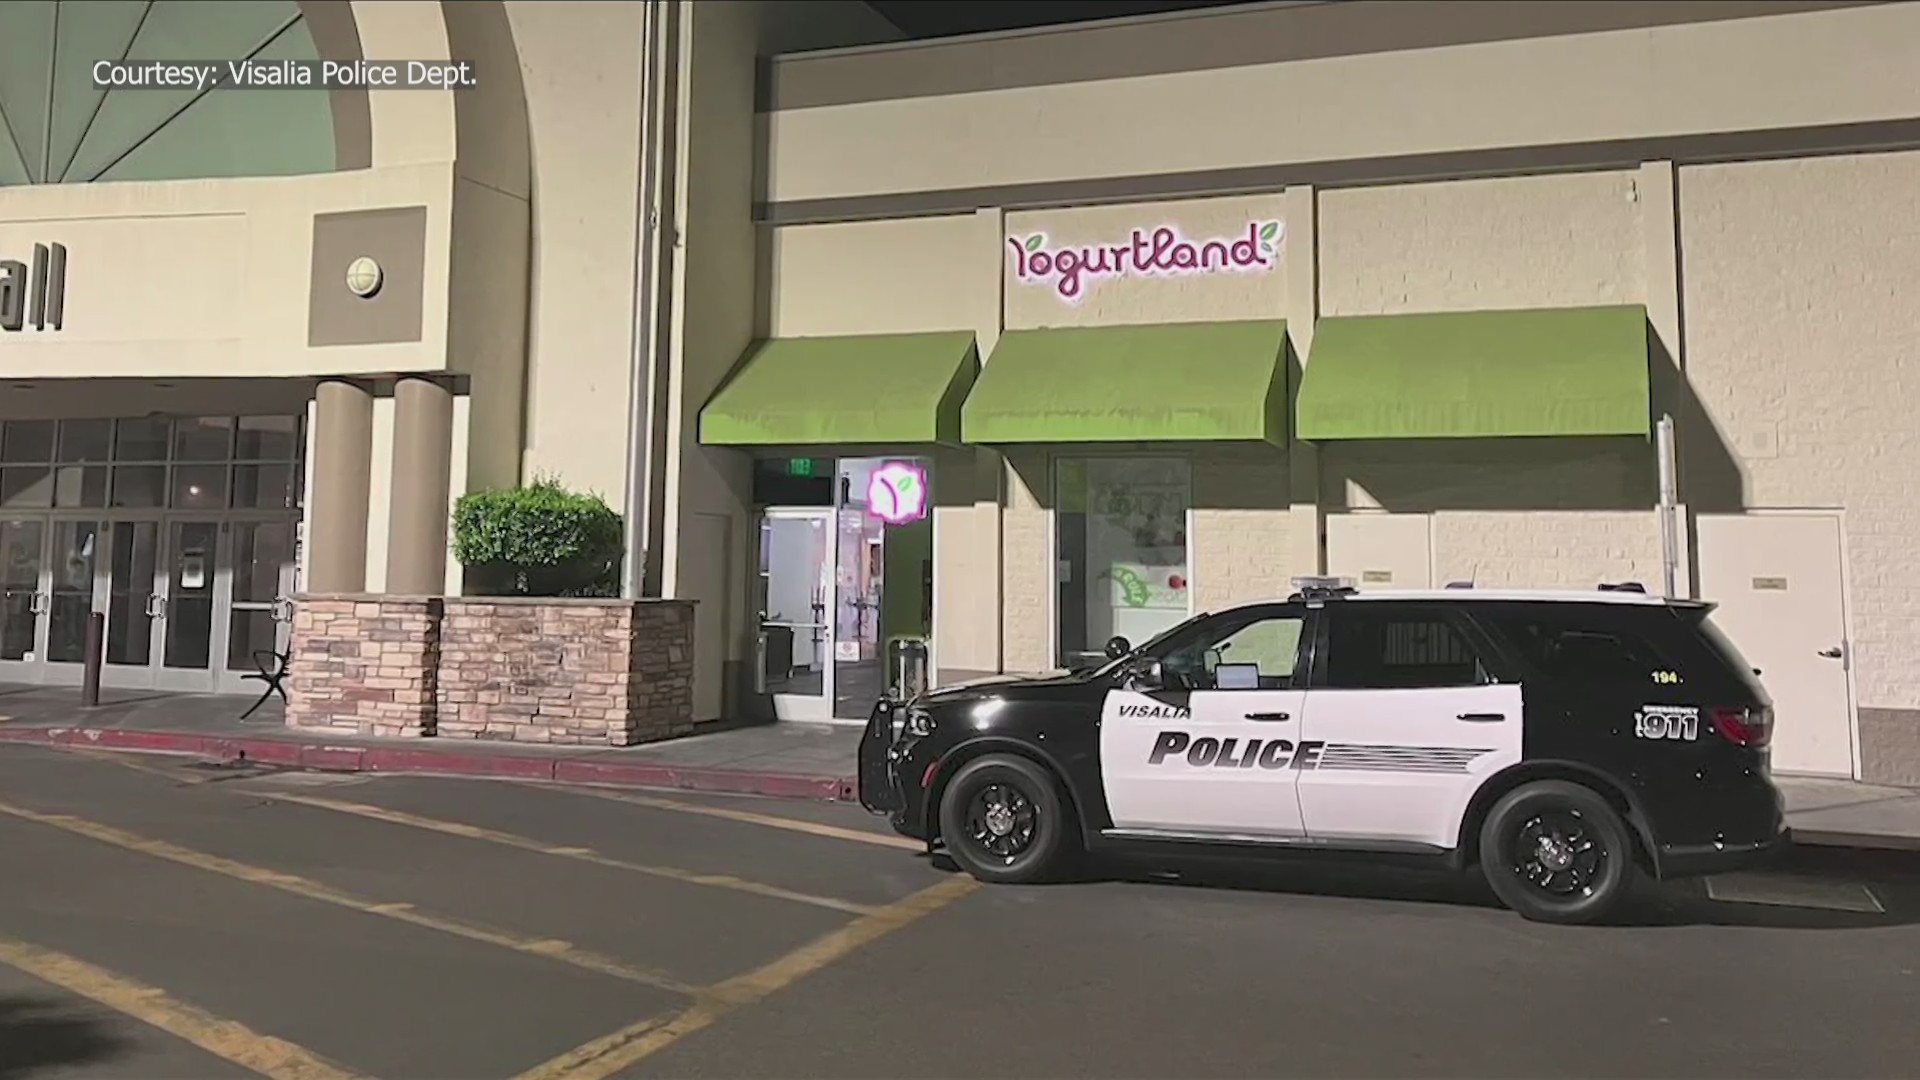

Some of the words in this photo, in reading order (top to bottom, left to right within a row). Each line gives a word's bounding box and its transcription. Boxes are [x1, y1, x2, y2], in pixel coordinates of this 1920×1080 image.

[1008, 222, 1267, 296] Yogurtland
[1119, 704, 1192, 719] VISALIA
[1643, 713, 1699, 740] 911
